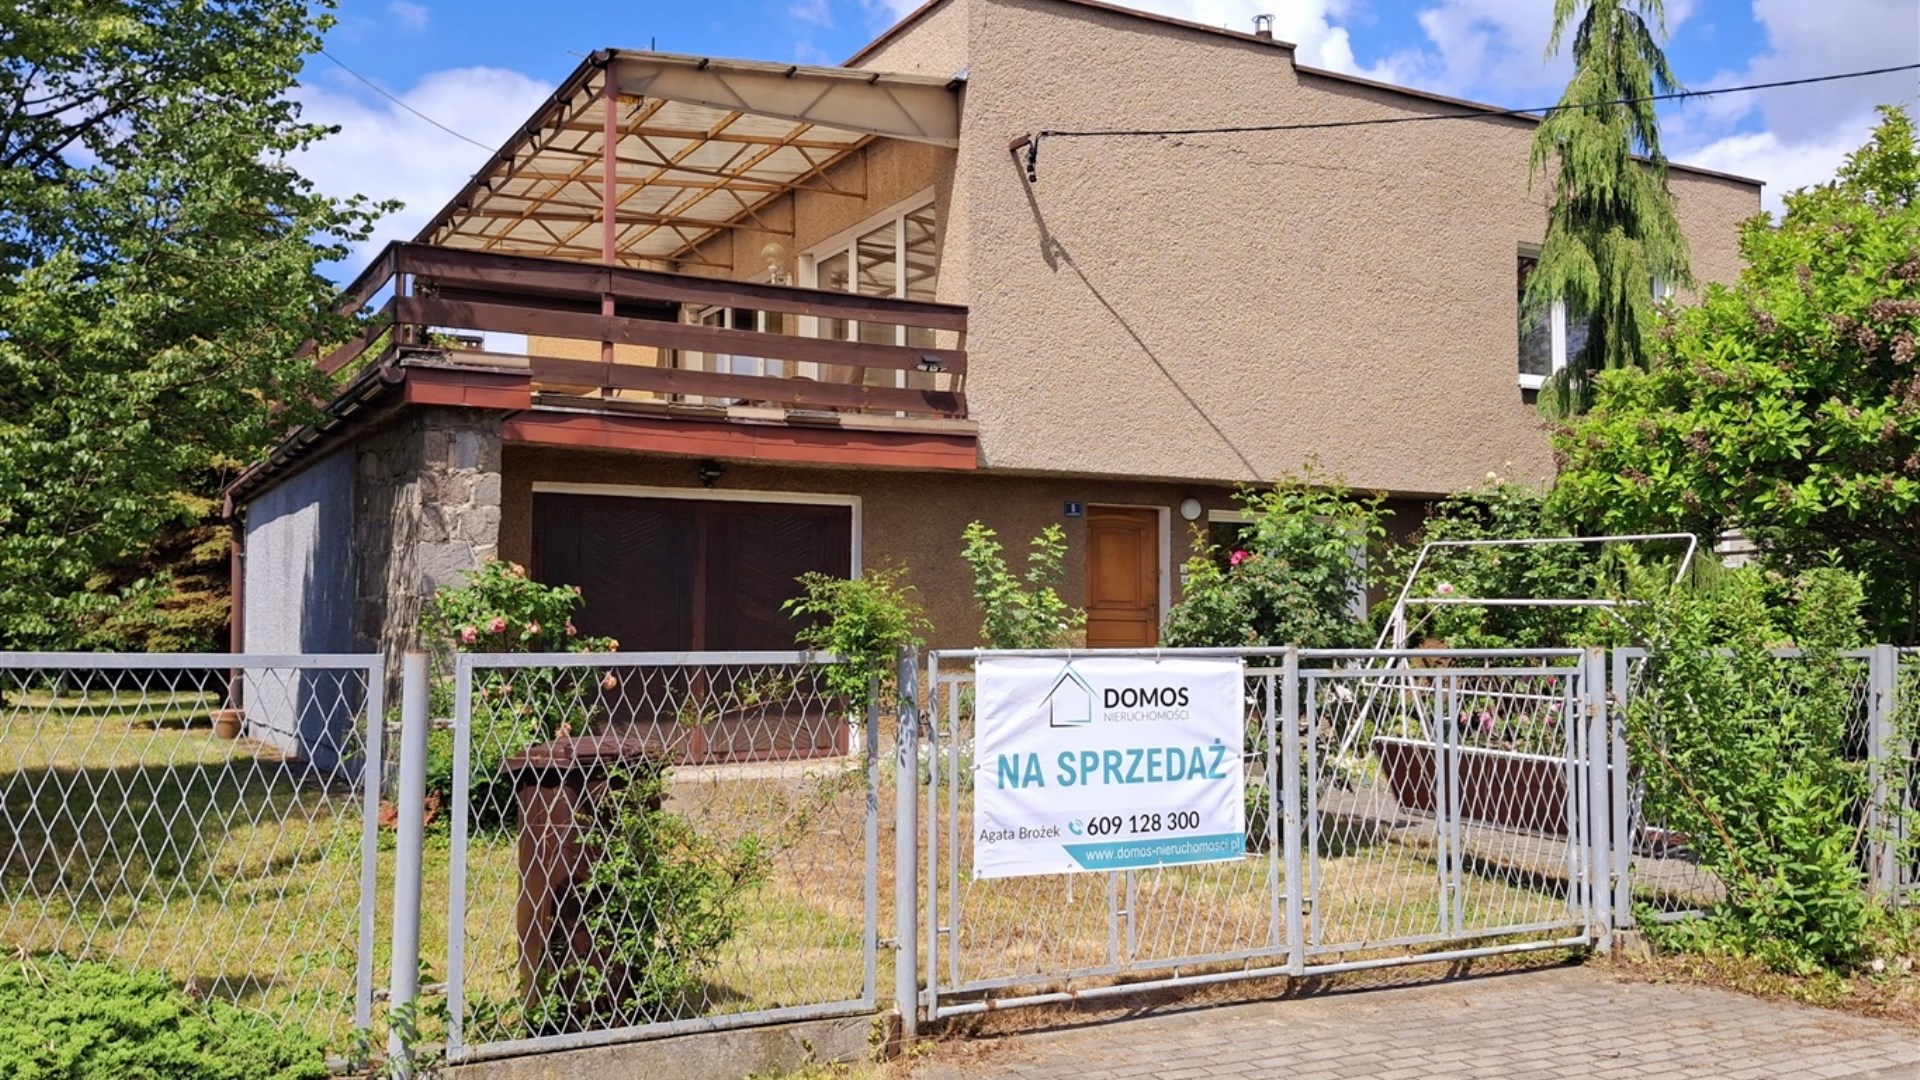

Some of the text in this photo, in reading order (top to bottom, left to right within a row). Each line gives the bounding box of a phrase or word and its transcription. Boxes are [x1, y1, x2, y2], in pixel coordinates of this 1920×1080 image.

[1103, 687, 1189, 709] DOMOS
[1103, 710, 1189, 723] NIERUCHOMOŚCI
[997, 738, 1227, 790] NA SPRZEDAŻ
[979, 825, 1061, 843] Agata Brożek
[1087, 811, 1200, 836] 609 128 300
[1085, 838, 1240, 861] www.domos-nieruchomosci.pl
